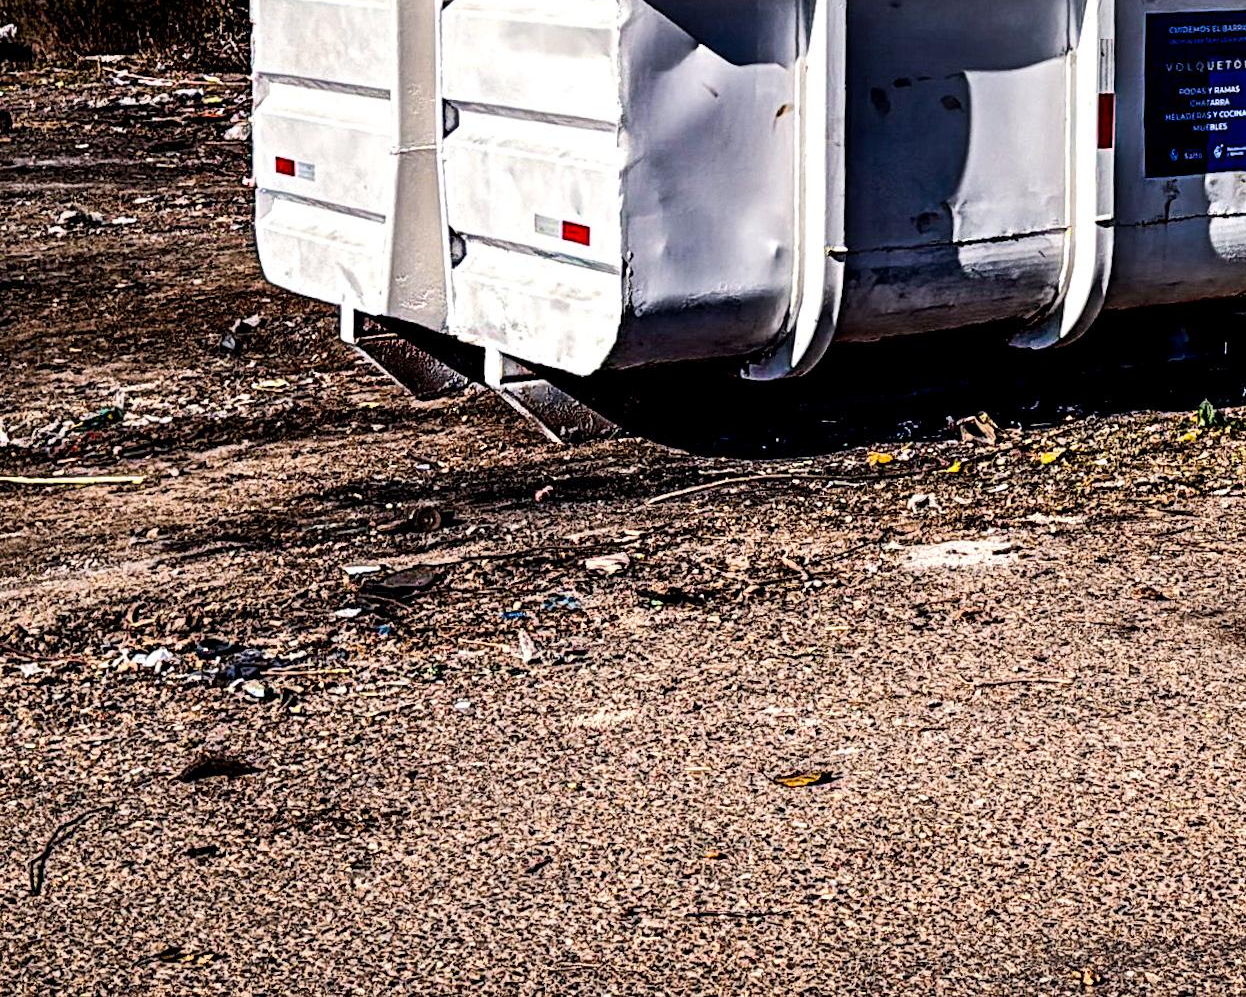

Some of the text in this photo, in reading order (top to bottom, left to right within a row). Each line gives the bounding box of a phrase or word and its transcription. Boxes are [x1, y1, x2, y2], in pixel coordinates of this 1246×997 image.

[1169, 25, 1210, 34] CUIDEMOS
[1212, 25, 1221, 33] EL
[1179, 87, 1206, 95] PODAS
[1214, 85, 1240, 94] RAMAS
[1190, 98, 1231, 107] CHATARRA
[1165, 111, 1211, 121] HELADERAS
[1213, 110, 1217, 118] Y
[1193, 122, 1228, 131] MUEBLES
